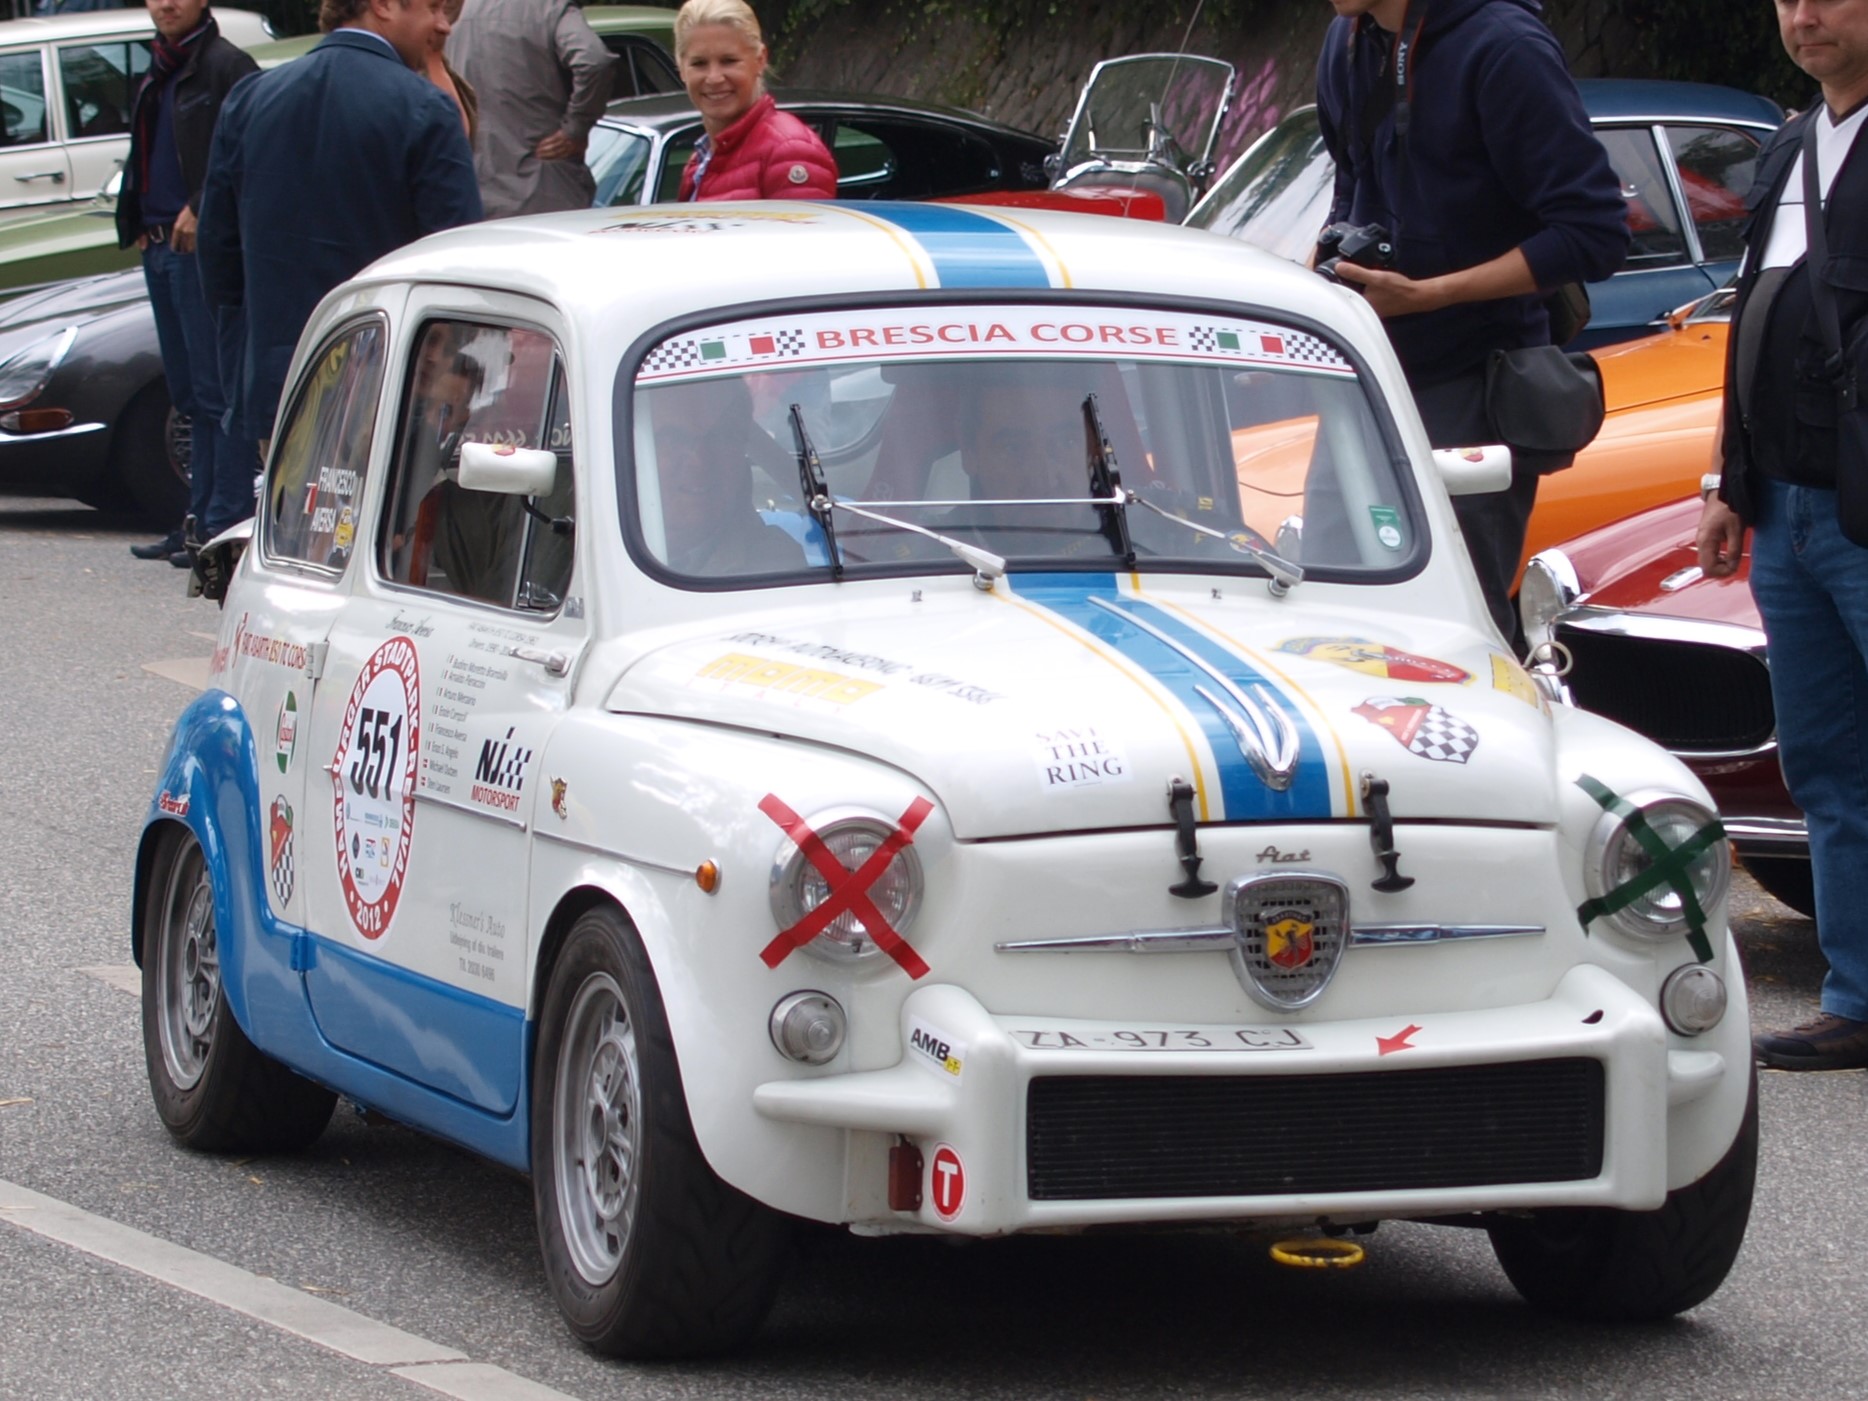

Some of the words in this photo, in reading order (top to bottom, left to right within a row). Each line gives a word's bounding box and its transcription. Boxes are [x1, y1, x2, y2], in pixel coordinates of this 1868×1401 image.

[816, 324, 1016, 349] BRESCIA
[1030, 323, 1179, 346] CORSE
[350, 707, 402, 800] 551
[1046, 741, 1109, 760] THE
[1047, 757, 1122, 785] RING
[471, 784, 520, 812] MOTORSPORT
[356, 899, 382, 932] 2012
[910, 1027, 950, 1062] AMB
[937, 1160, 958, 1208] T
